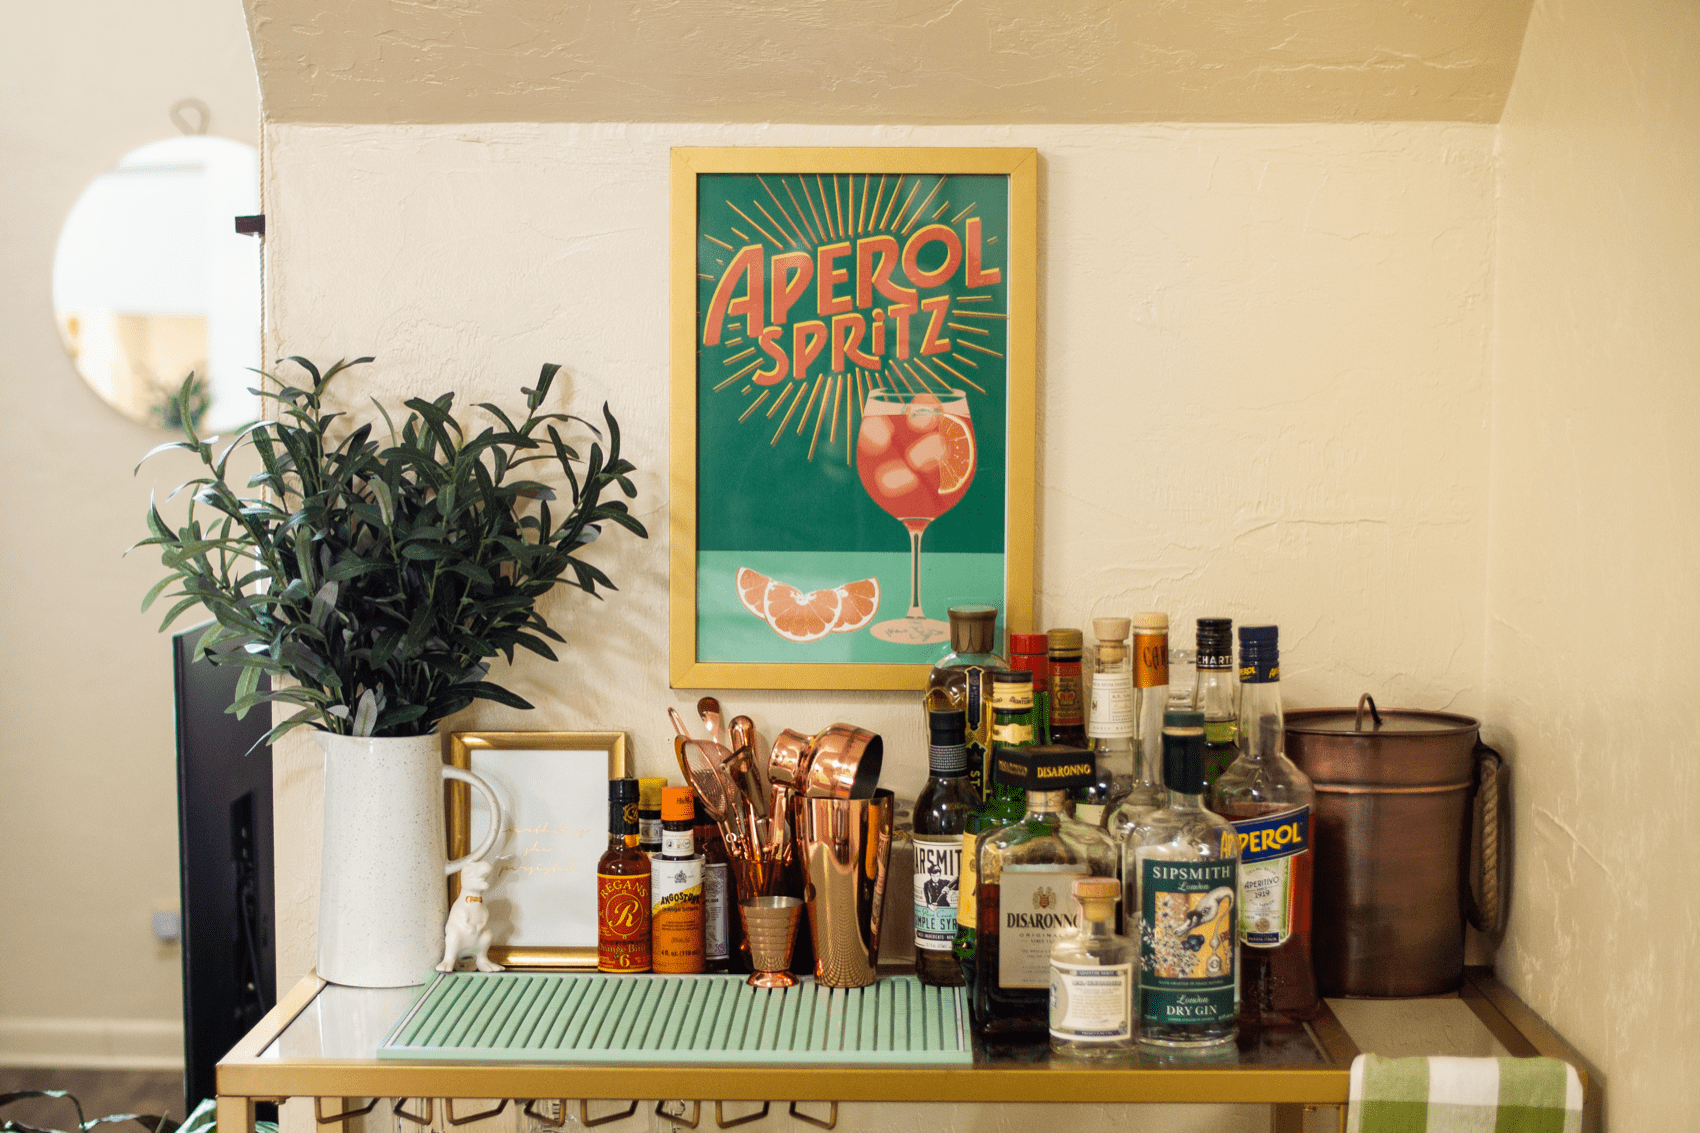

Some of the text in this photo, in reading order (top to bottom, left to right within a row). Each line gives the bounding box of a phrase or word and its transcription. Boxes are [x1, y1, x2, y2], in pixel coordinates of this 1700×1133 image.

[703, 216, 1001, 347] APEROL
[1037, 763, 1091, 778] DISARONNO
[913, 846, 962, 876] ARSMIT
[1152, 865, 1231, 880] SIPSMITH
[1178, 881, 1210, 892] London
[1244, 876, 1280, 889] APERITIVO
[1254, 889, 1271, 899] 1919
[940, 918, 957, 930] SYR
[619, 953, 631, 968] 6
[1176, 993, 1210, 1005] London
[1166, 1004, 1218, 1016] DRY GIN
